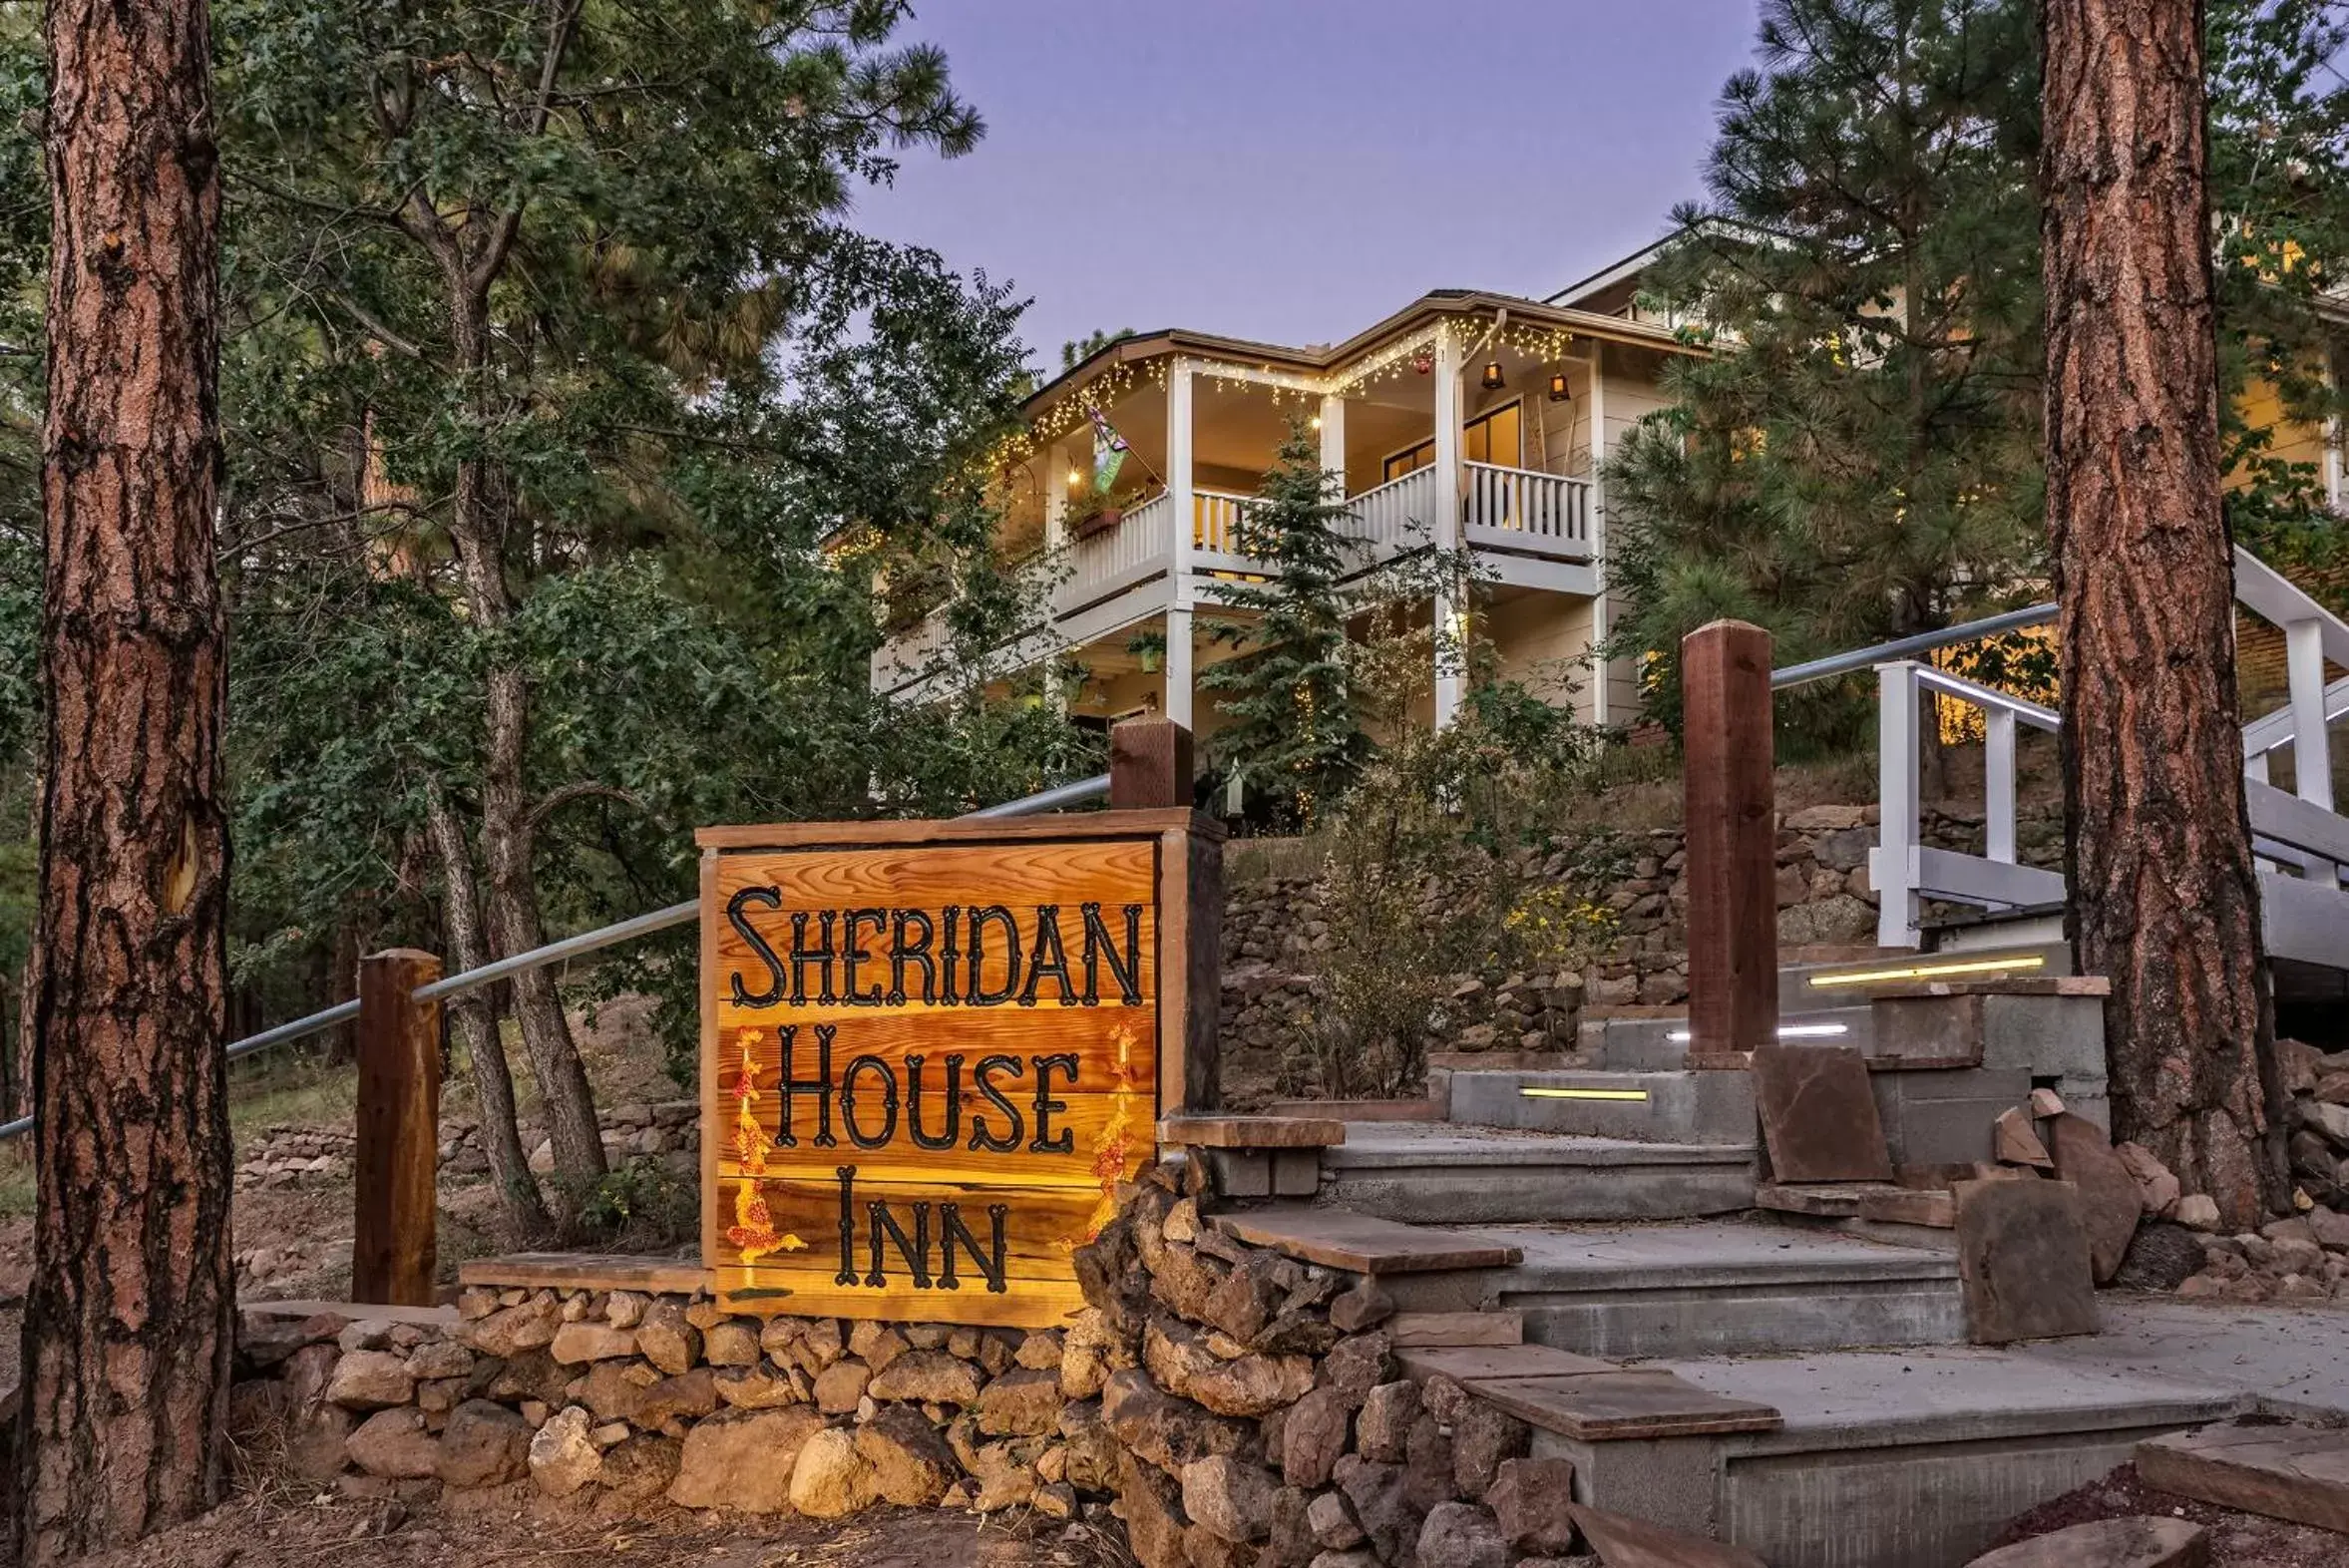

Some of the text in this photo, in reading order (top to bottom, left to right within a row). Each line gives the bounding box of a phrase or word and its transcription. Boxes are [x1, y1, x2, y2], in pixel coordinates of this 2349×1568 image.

[727, 886, 1142, 1007] SHERIDAN
[775, 1024, 1079, 1153] HOUSE
[835, 1165, 1007, 1293] INN
